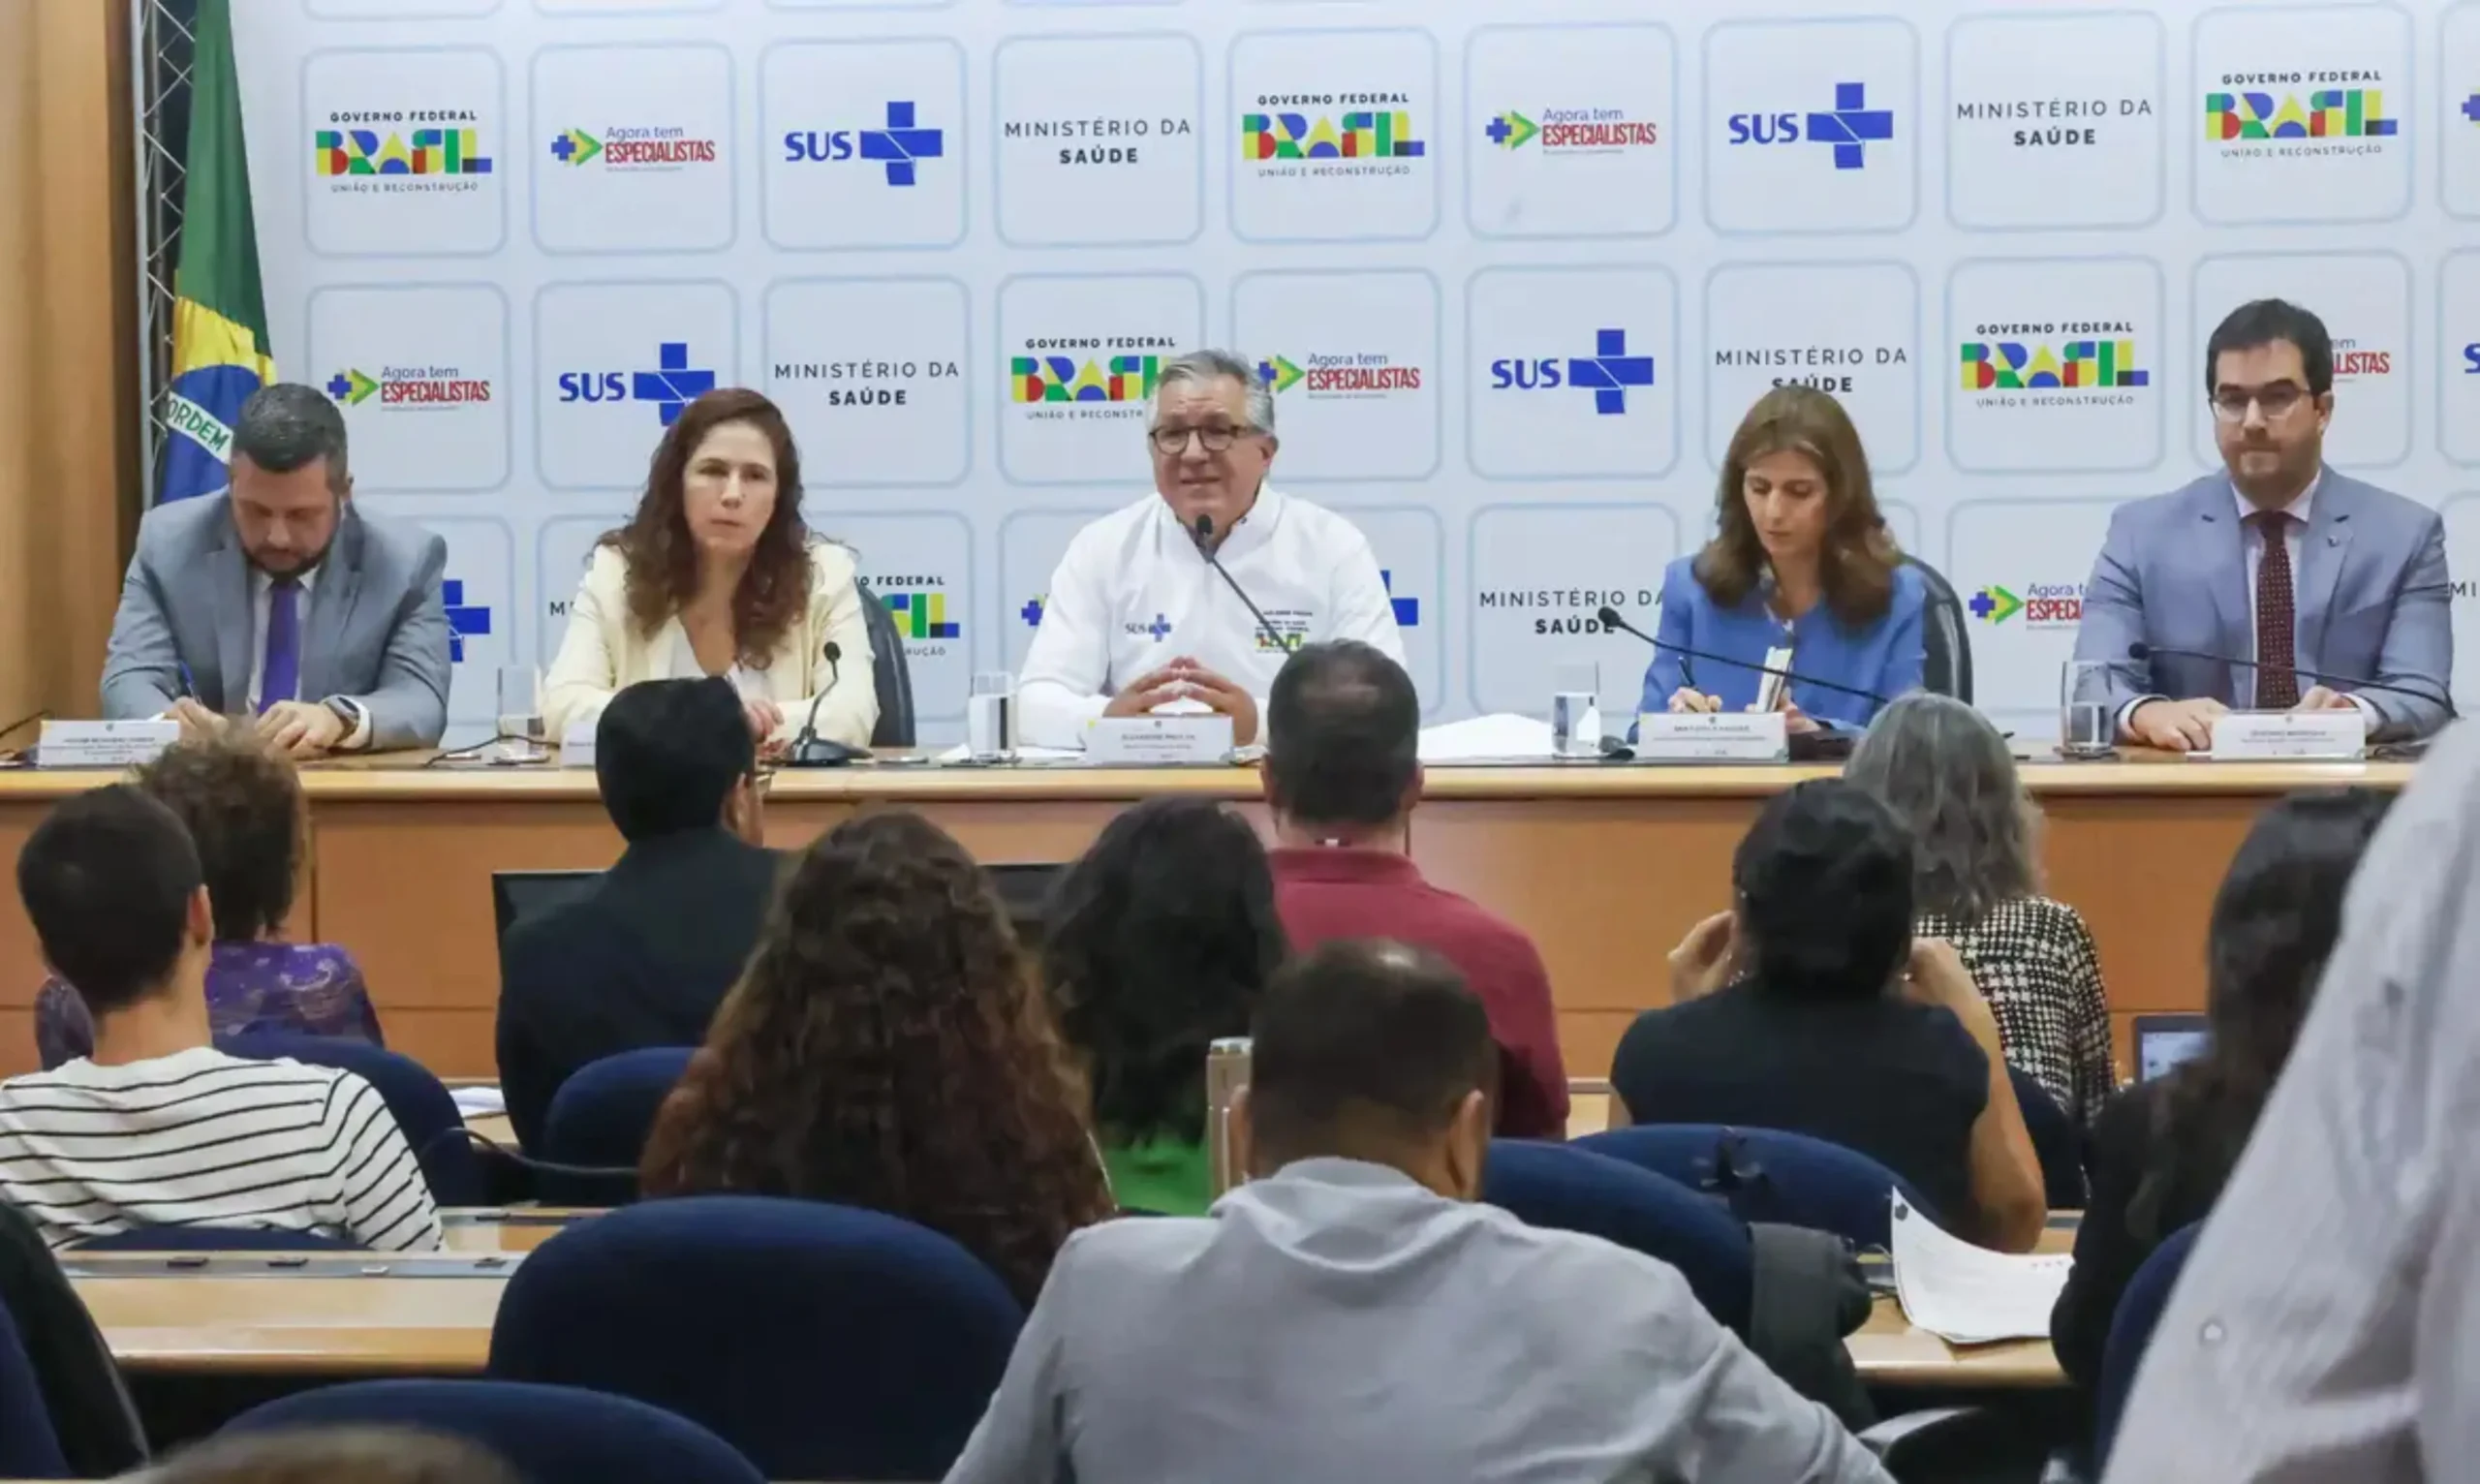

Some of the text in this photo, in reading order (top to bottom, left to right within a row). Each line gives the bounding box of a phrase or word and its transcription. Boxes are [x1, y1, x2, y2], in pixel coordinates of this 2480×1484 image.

[2221, 71, 2382, 85] GOVERNO FEDERAL
[1257, 93, 1410, 106] GOVERNO FEDERAL
[1957, 98, 2152, 120] MINISTÉRIO DA
[330, 109, 477, 122] GOVERNO FEDERAL
[1543, 107, 1624, 124] Agora tem
[2205, 89, 2398, 140] BRASIL
[604, 126, 684, 142] Agora tem
[1005, 115, 1192, 138] MINISTÉRIO DA
[1242, 111, 1425, 160] BRASIL
[1542, 122, 1657, 146] ESPECIALISTAS
[1728, 112, 1799, 144] SUS
[2014, 126, 2095, 147] SAÚDE
[316, 129, 492, 175] BRASIL
[604, 139, 716, 164] ESPECIALISTAS
[785, 131, 852, 162] SUS
[1059, 143, 1138, 165] SAÚDE
[2220, 146, 2262, 159] UNIÃO
[2267, 146, 2274, 158] E
[1257, 166, 1296, 178] UNIÃO
[1300, 166, 1308, 177] E
[330, 183, 367, 194] UNIÃO
[373, 183, 380, 193] E
[1976, 322, 2133, 334] GOVERNO FEDERAL
[1026, 337, 1176, 350] GOVERNO FEDERAL
[1308, 353, 1387, 368] Agora tem
[1716, 345, 1907, 366] MINISTÉRIO DA
[1961, 340, 2149, 389] BRASIL
[382, 366, 459, 381] Agora tem
[775, 359, 959, 380] MINISTÉRIO DA
[1011, 356, 1169, 402] BRASI
[1308, 367, 1420, 390] ESPECIALISTAS
[1492, 358, 1561, 389] SUS
[381, 381, 490, 403] ESPECIALISTAS
[559, 372, 626, 402] SUS
[829, 386, 907, 406] SAÚDE
[1976, 396, 2015, 408] UNIÃO
[2021, 396, 2028, 407] E
[1026, 409, 1065, 419] UNIÃO
[1070, 409, 1076, 418] E
[168, 398, 230, 452] ORDEM
[877, 576, 945, 586] FEDERAL
[1479, 587, 1626, 606] MINISTÉRIO
